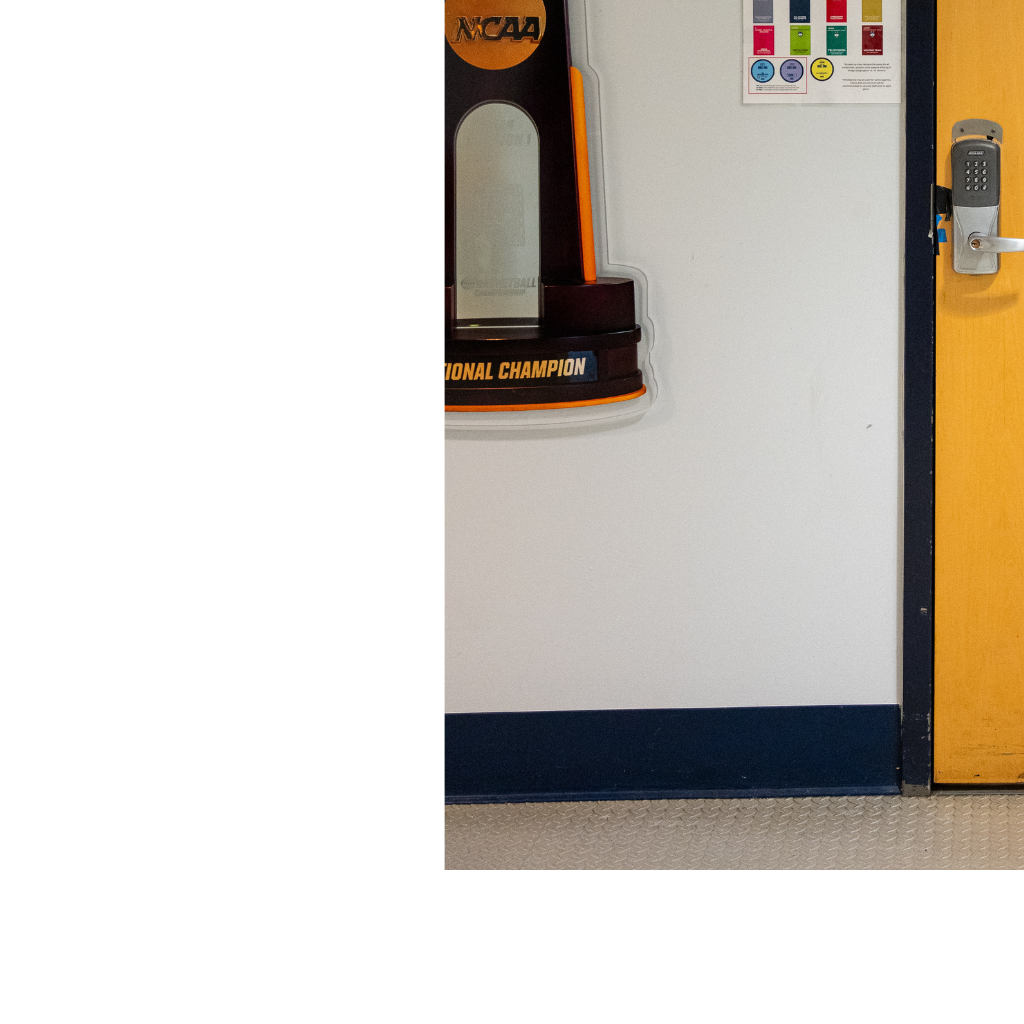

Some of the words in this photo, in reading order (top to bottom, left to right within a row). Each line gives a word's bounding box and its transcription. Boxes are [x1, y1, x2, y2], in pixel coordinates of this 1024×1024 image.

[453, 16, 540, 41] NCAA
[445, 362, 494, 380] IONAL
[498, 357, 586, 380] CHAMPION
